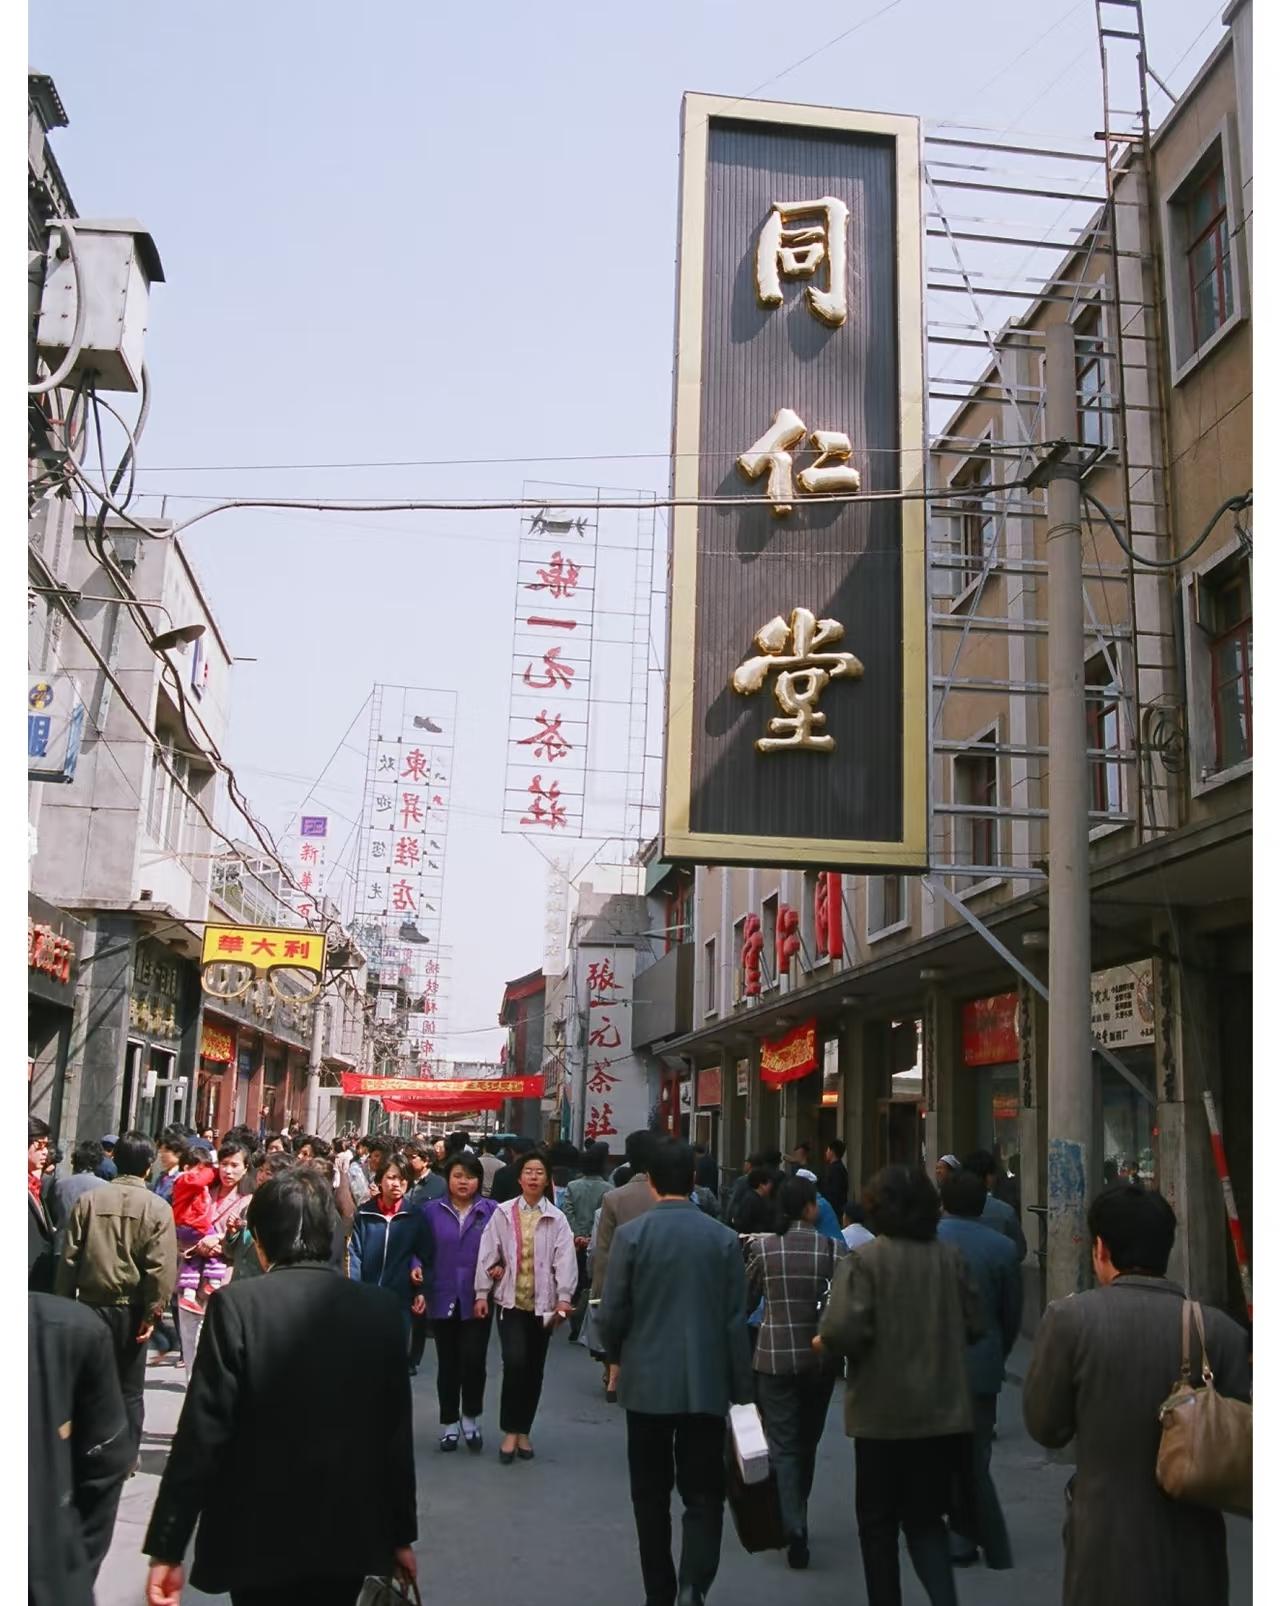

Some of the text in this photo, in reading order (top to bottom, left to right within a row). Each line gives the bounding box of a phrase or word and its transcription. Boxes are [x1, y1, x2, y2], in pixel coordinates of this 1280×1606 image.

[733, 196, 864, 752] 同仁堂
[218, 935, 311, 960] 華大利
